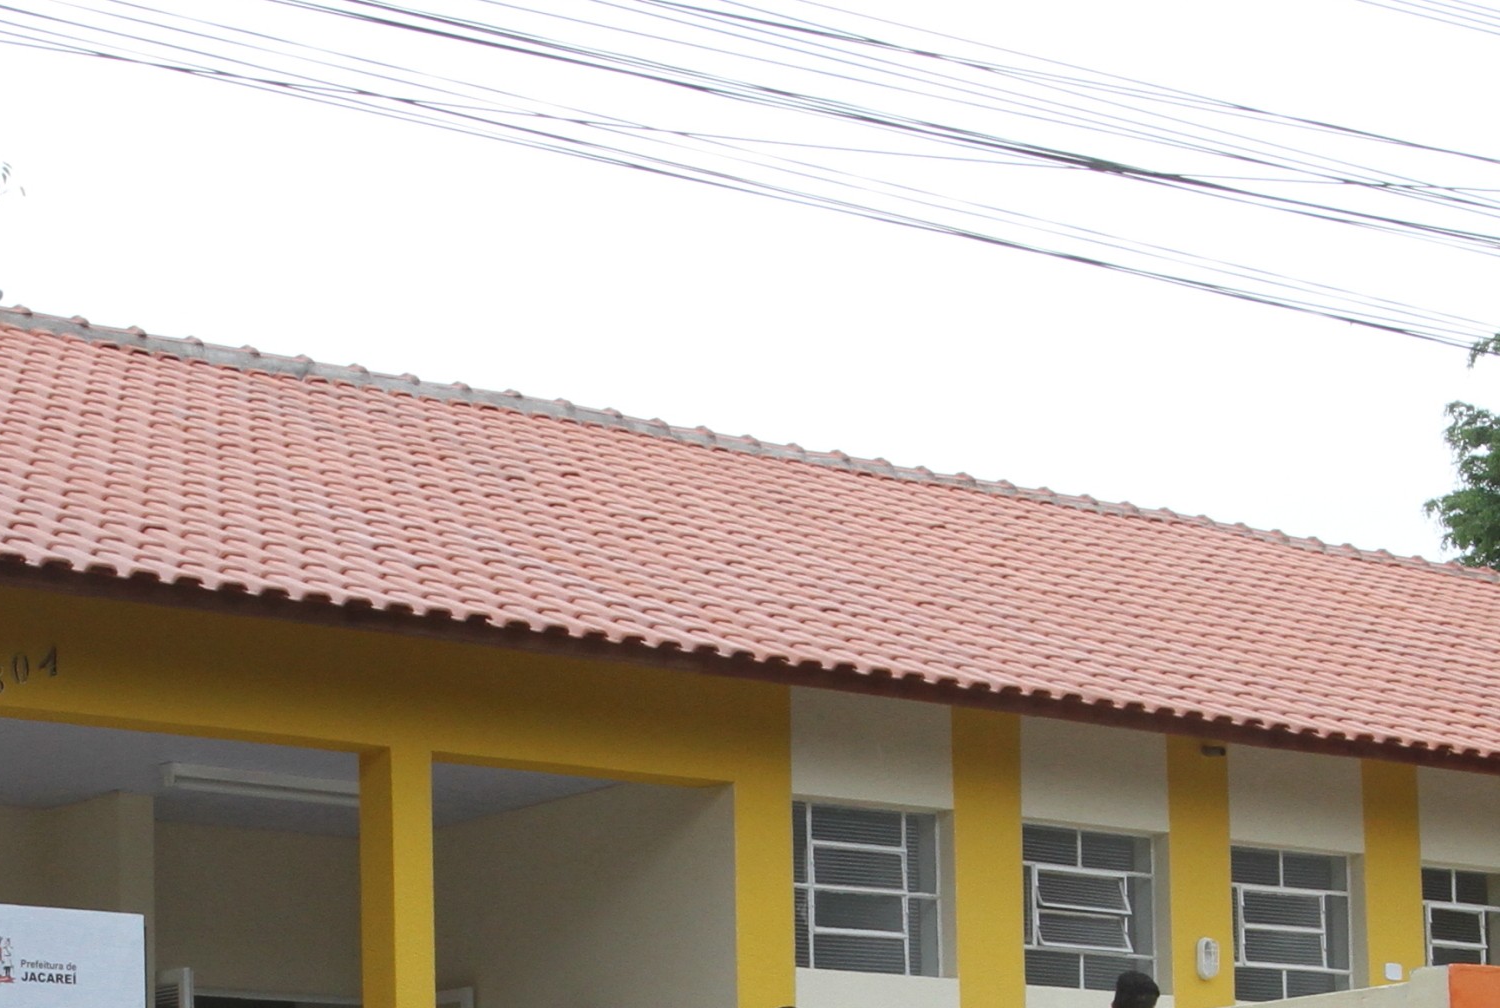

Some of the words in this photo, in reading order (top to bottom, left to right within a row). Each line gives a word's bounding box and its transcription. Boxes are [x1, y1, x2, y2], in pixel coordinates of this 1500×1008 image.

[20, 959, 64, 971] Prefeitura
[66, 962, 77, 971] de
[21, 971, 77, 985] JACAREÍ
